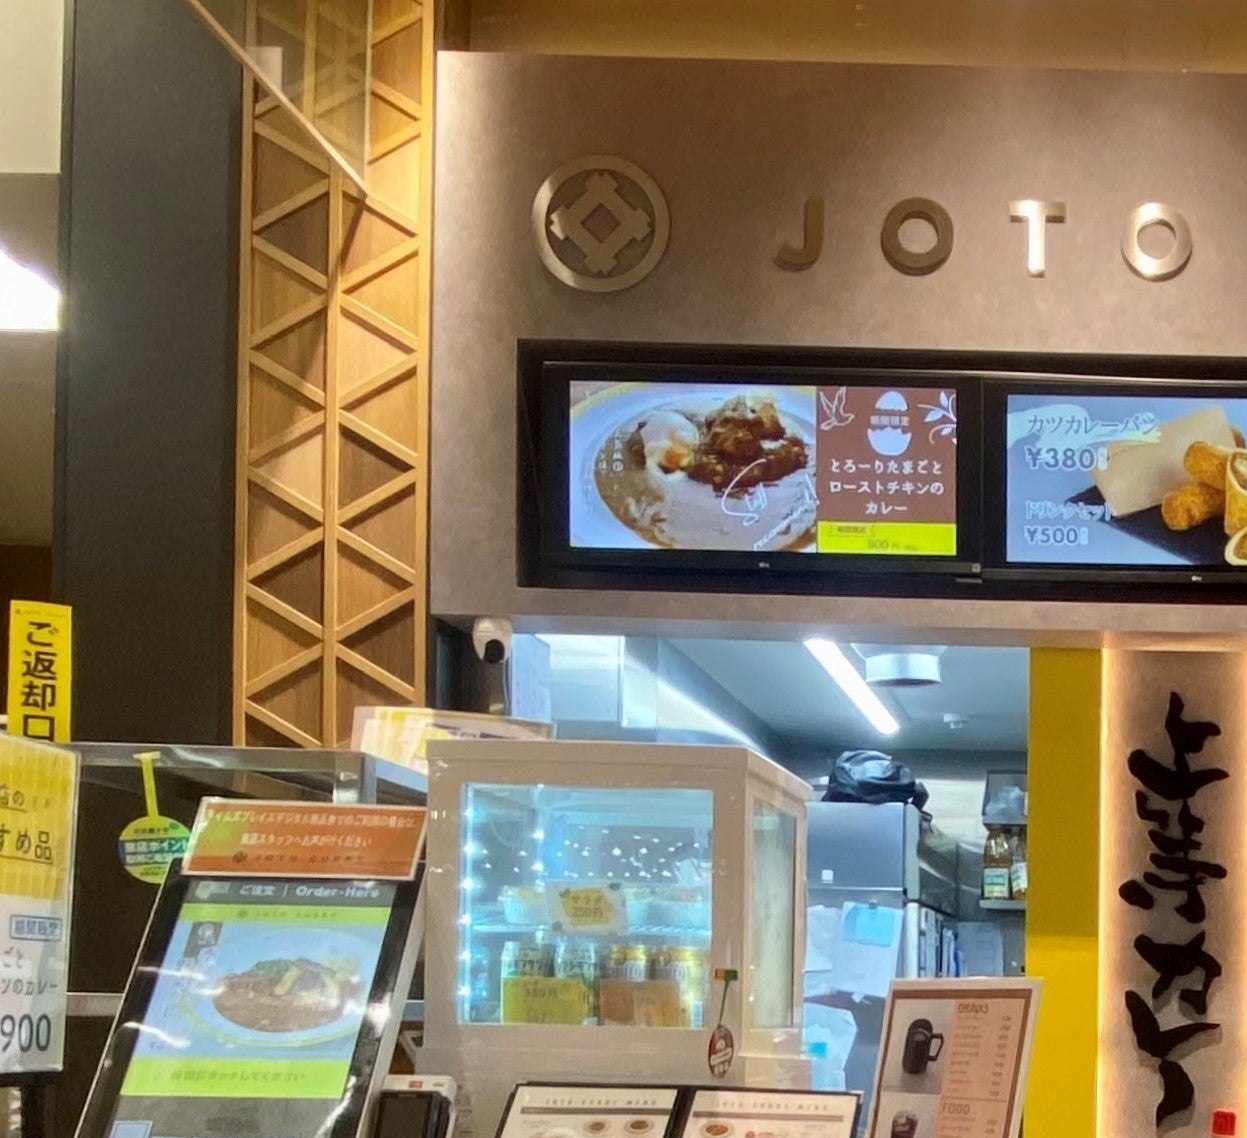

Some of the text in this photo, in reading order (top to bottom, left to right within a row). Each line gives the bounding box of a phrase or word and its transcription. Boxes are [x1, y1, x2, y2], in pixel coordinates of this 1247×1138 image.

[774, 197, 1193, 282] JOTO
[1027, 413, 1160, 436] カツカレーパン
[830, 458, 943, 476] とろーりたまごと
[1026, 446, 1096, 471] ¥380
[829, 480, 945, 496] ローストチキンの
[865, 502, 908, 516] カレー
[1025, 526, 1080, 547] ¥500
[21, 621, 59, 742] ご返却口
[0, 1013, 51, 1053] 900
[941, 1102, 971, 1116] FOOD
